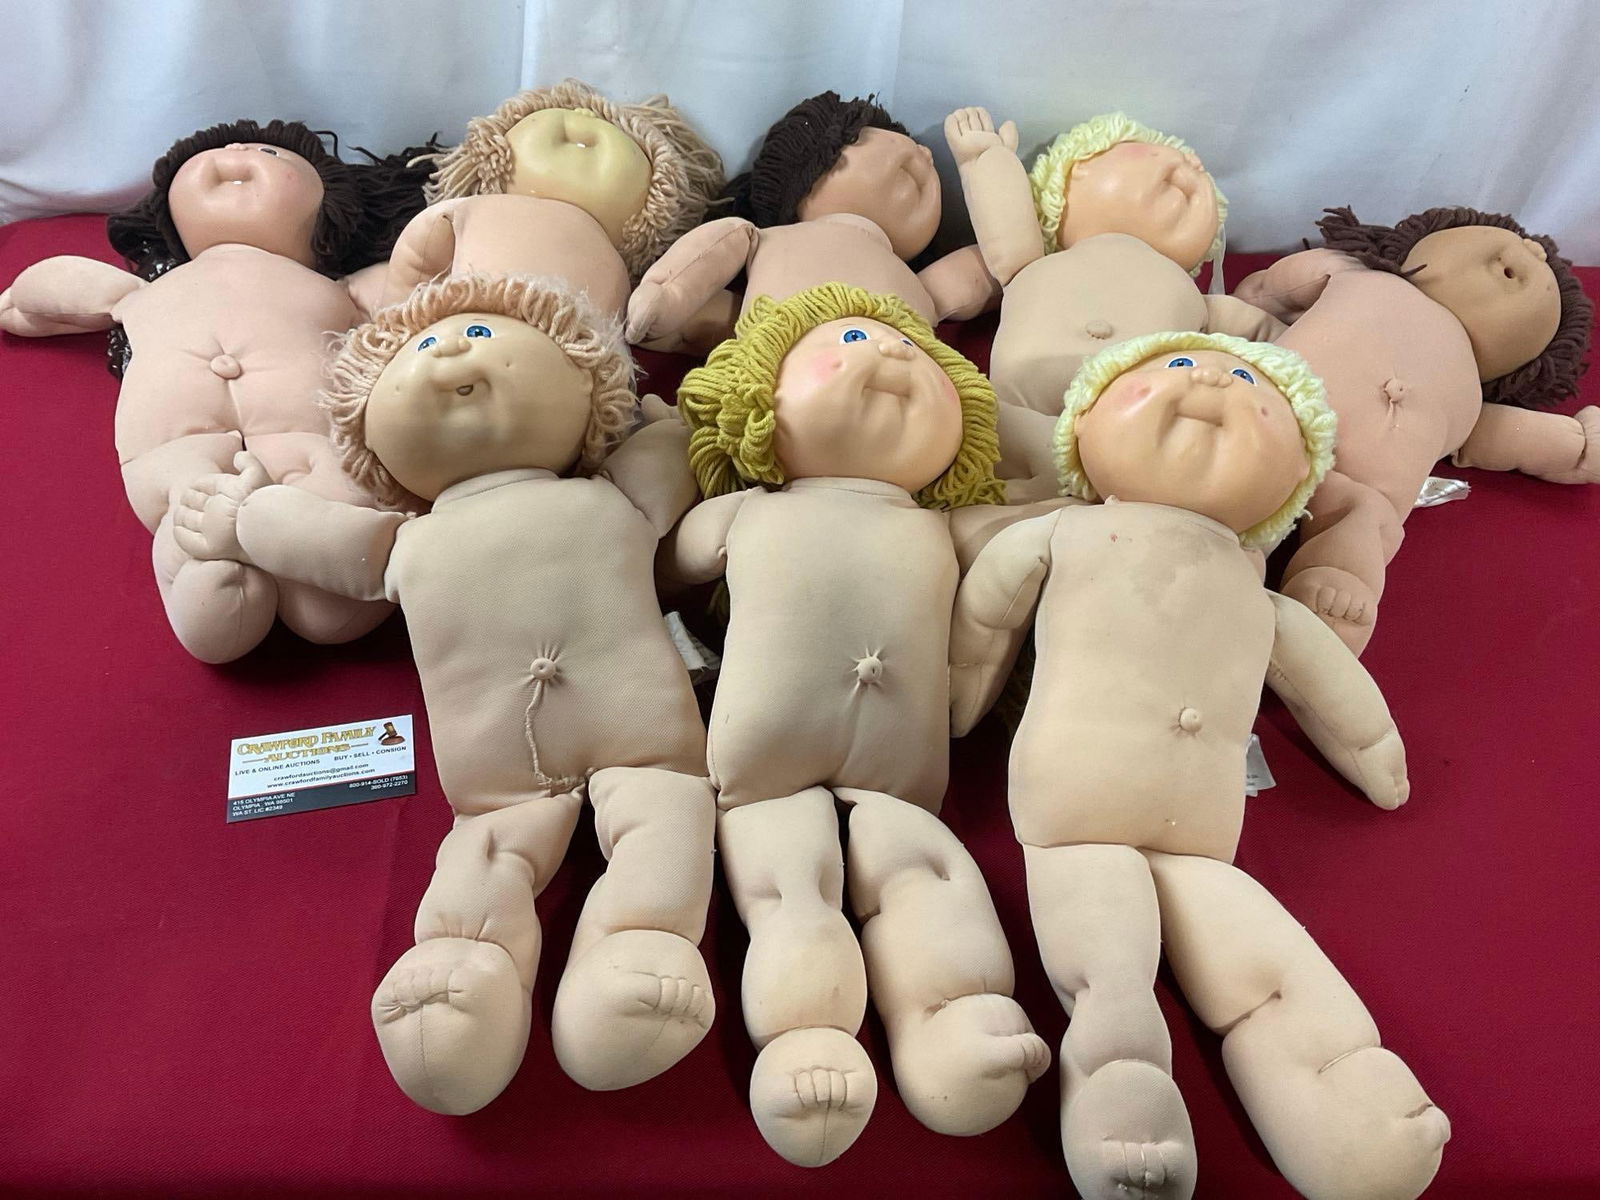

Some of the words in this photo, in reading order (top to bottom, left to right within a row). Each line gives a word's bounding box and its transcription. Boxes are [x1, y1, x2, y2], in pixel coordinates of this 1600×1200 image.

[237, 736, 319, 755] CRAWFORD
[321, 726, 376, 744] FAMILY
[264, 744, 351, 762] AUCTIONS
[353, 751, 370, 759] SELL
[376, 746, 407, 755] CONSIGN
[258, 764, 283, 772] ONLINE
[285, 759, 321, 768] AUCTIONS
[245, 795, 272, 804] OLYMPIA
